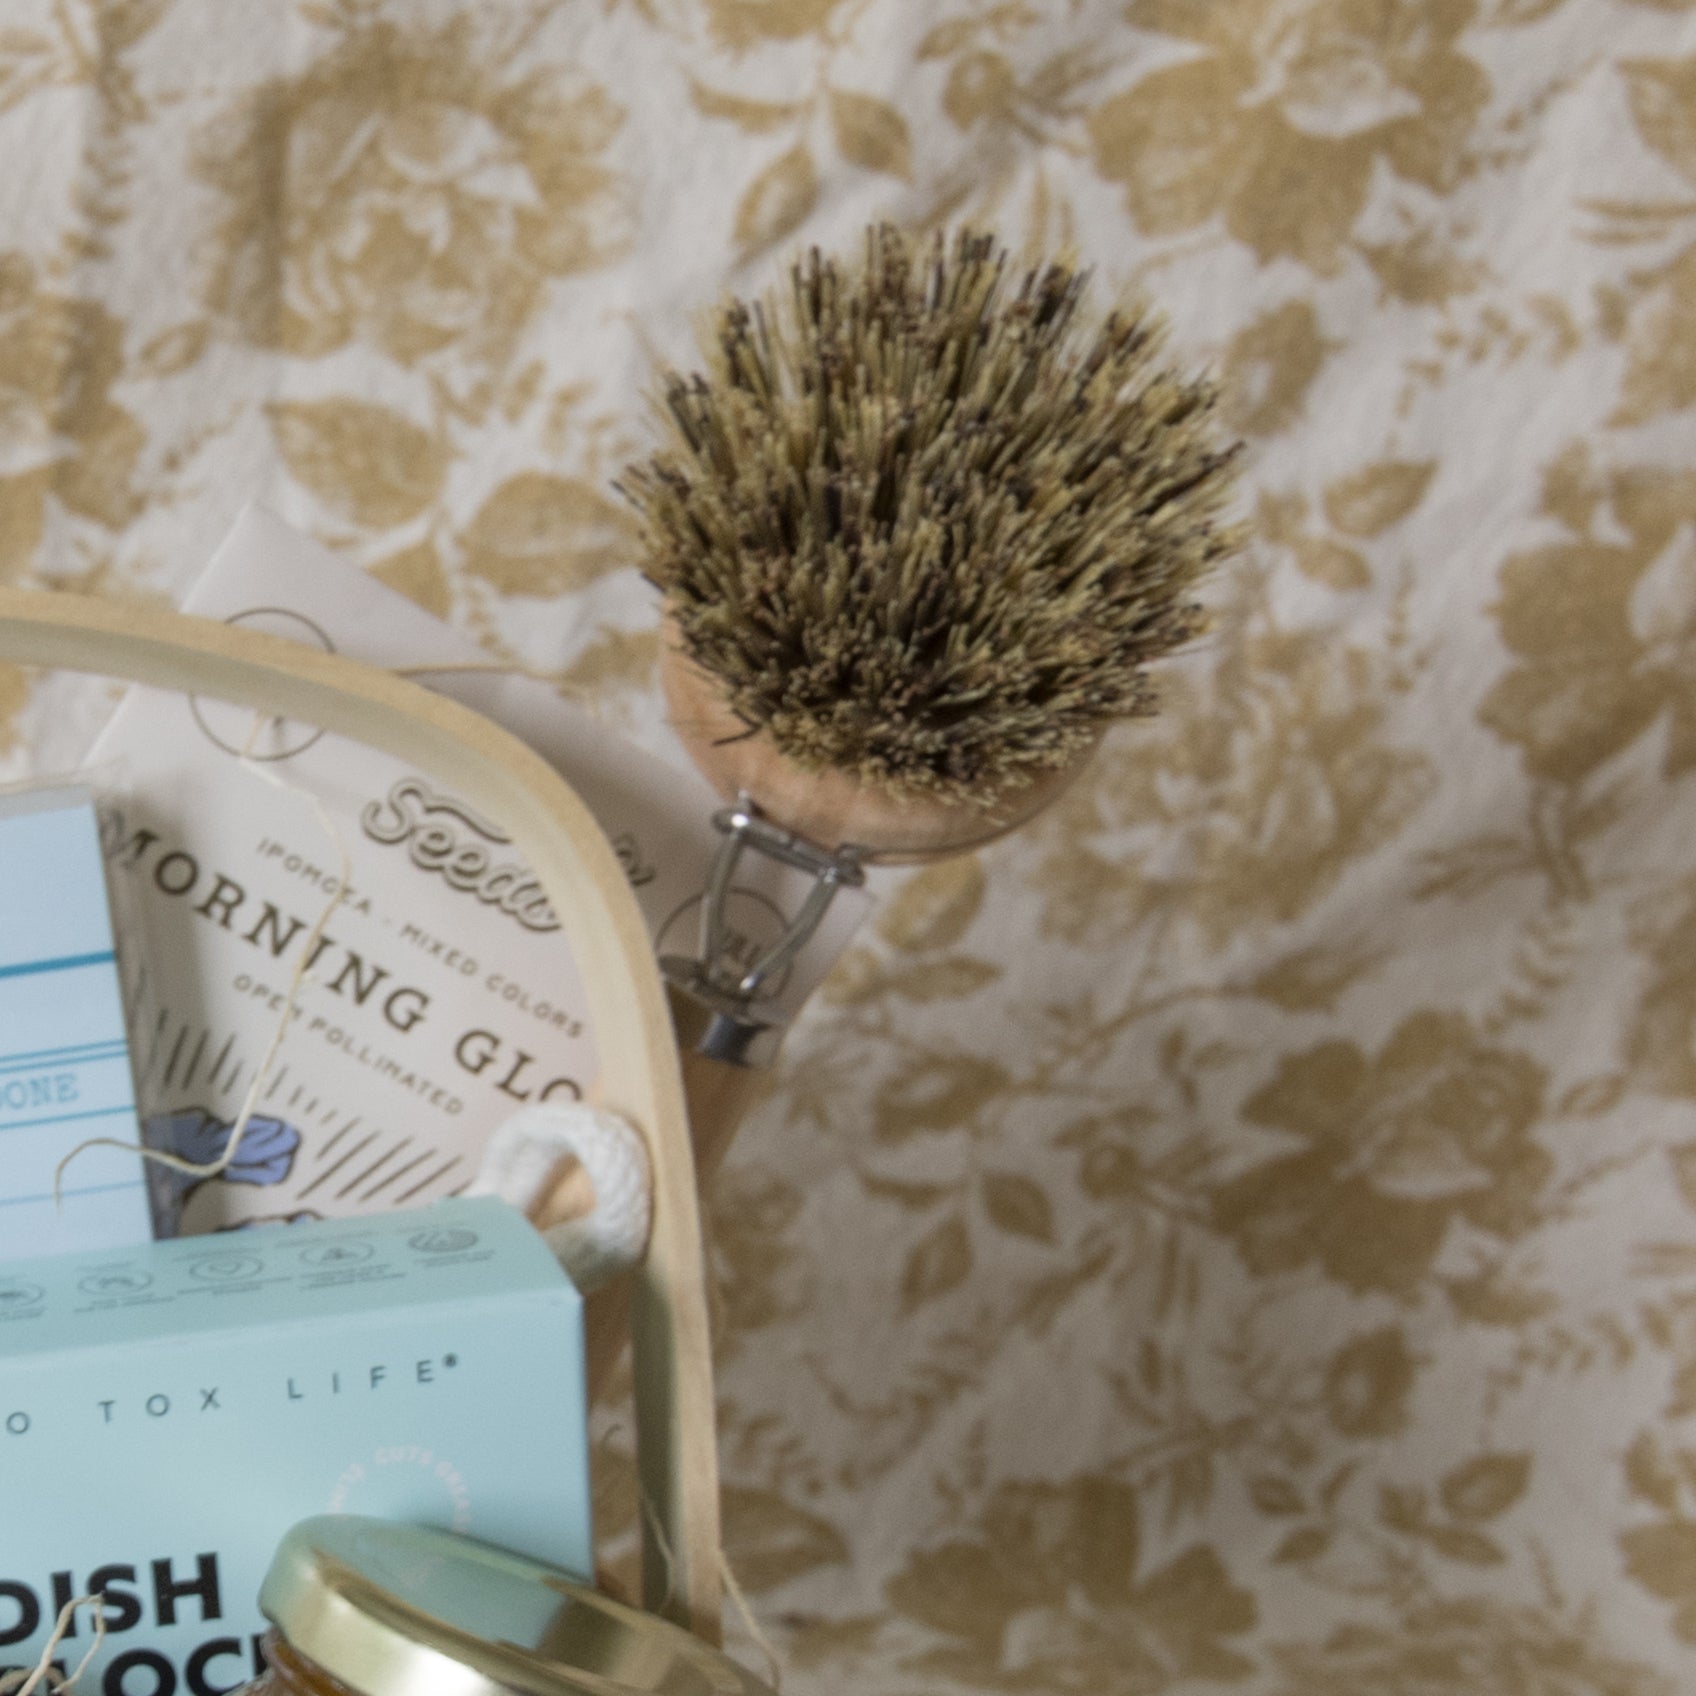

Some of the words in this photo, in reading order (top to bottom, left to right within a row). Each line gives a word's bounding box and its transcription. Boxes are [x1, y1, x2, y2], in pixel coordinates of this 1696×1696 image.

[400, 924, 478, 976] MIXED
[486, 974, 583, 1039] COLORS
[309, 1016, 463, 1115] POLLINATED
[97, 1386, 223, 1427] TOX
